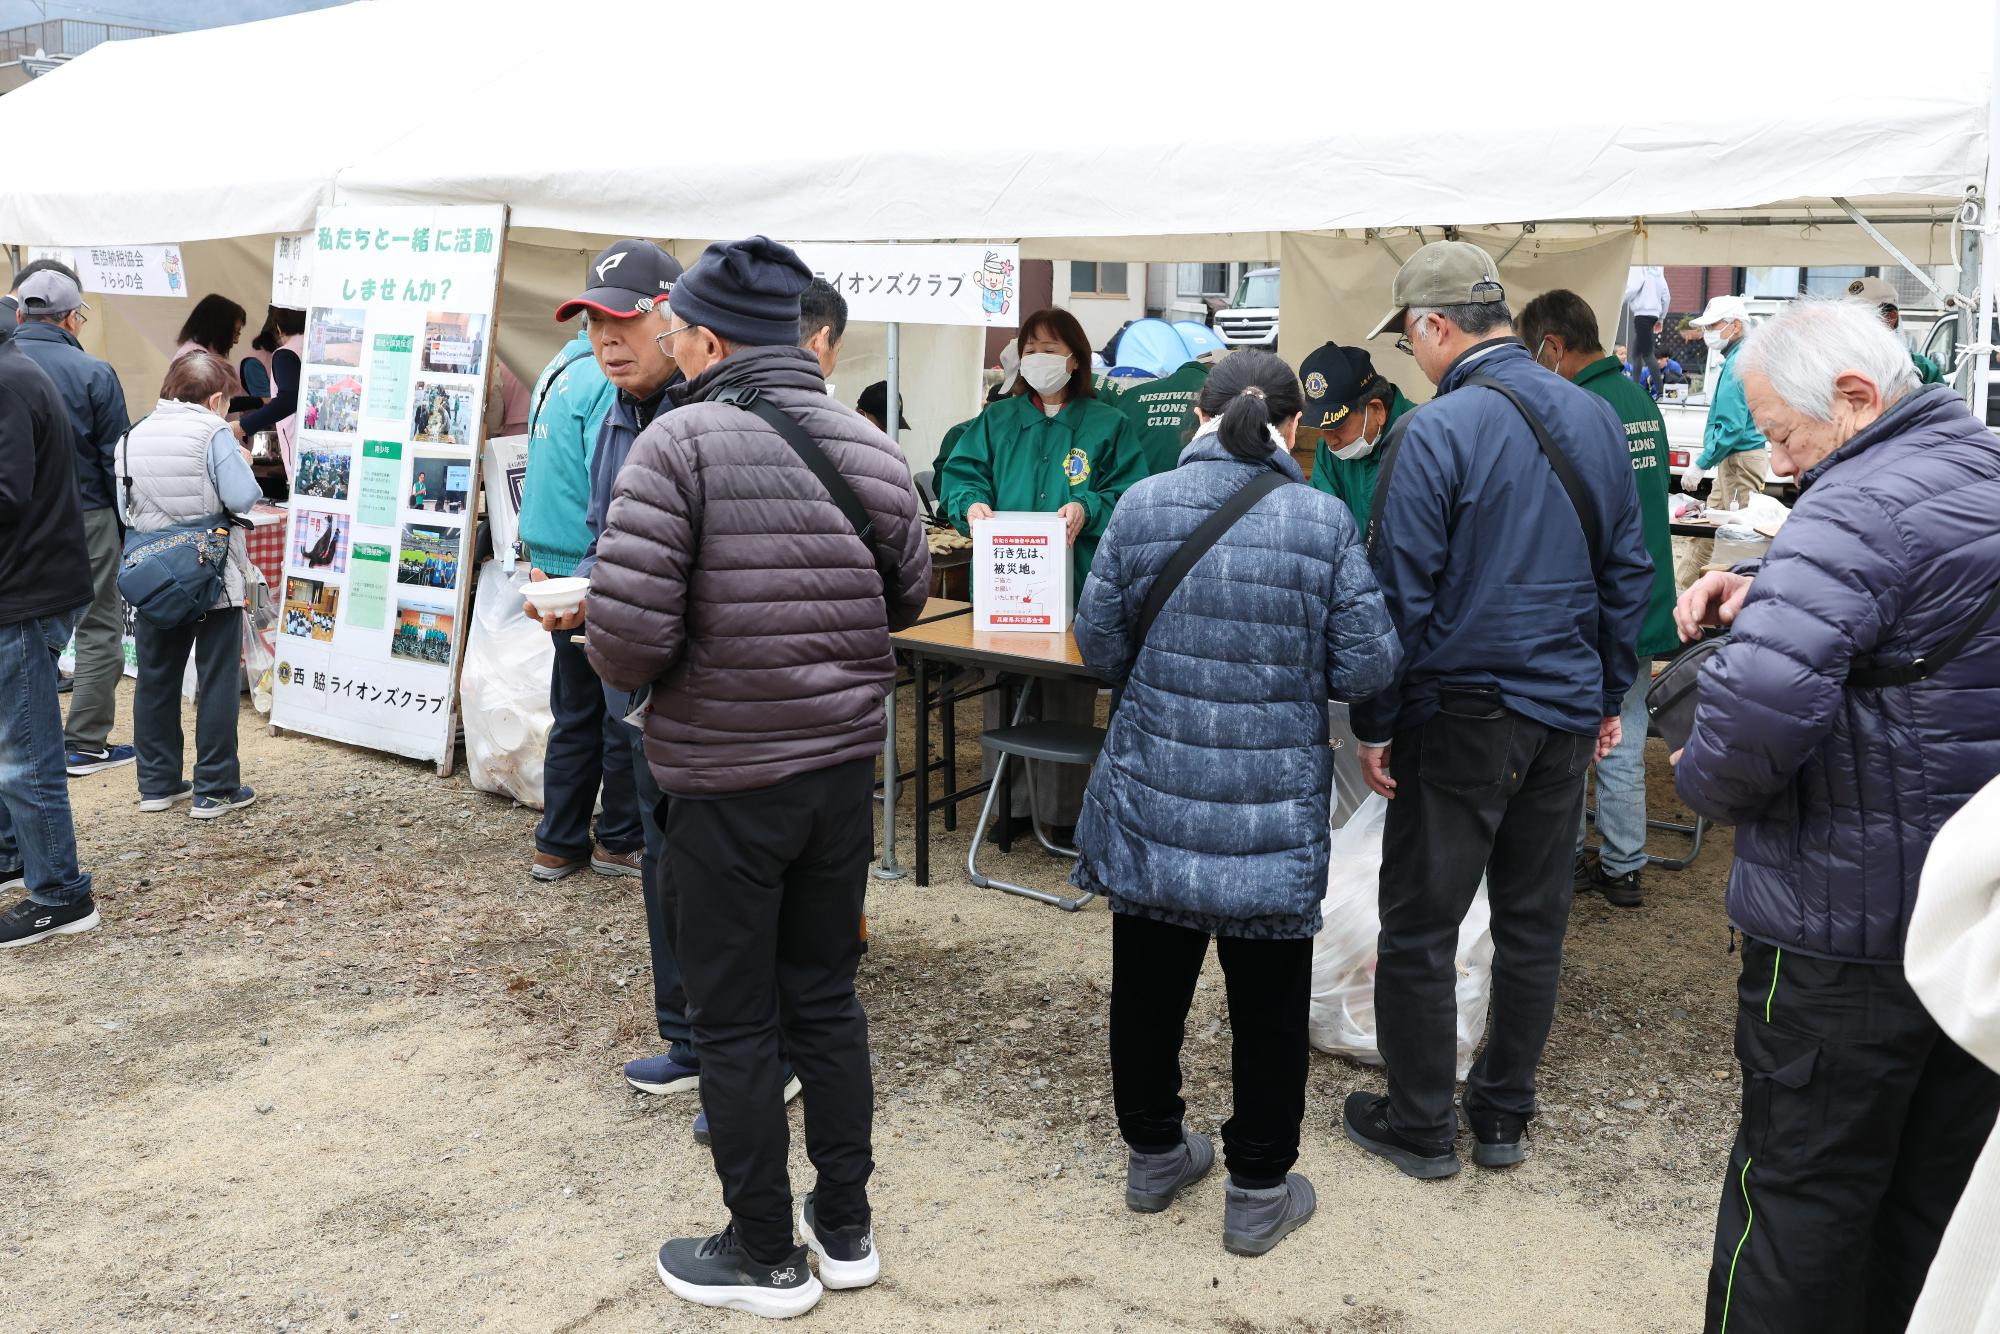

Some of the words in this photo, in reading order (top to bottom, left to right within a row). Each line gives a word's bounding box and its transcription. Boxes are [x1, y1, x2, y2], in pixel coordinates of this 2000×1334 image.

[317, 226, 494, 254] 私たちと一緒に活動
[101, 272, 144, 290] うららの会
[342, 278, 452, 302] しませんか？
[1147, 403, 1188, 414] LIONS
[1320, 404, 1350, 428] Lions
[1147, 416, 1181, 427] CLUB
[1623, 419, 1660, 435] SHIWAKI
[1627, 437, 1656, 453] LIONS
[1631, 455, 1657, 470] CLUB
[993, 547, 1045, 560] 行き先は、
[994, 562, 1036, 575] 被災地。
